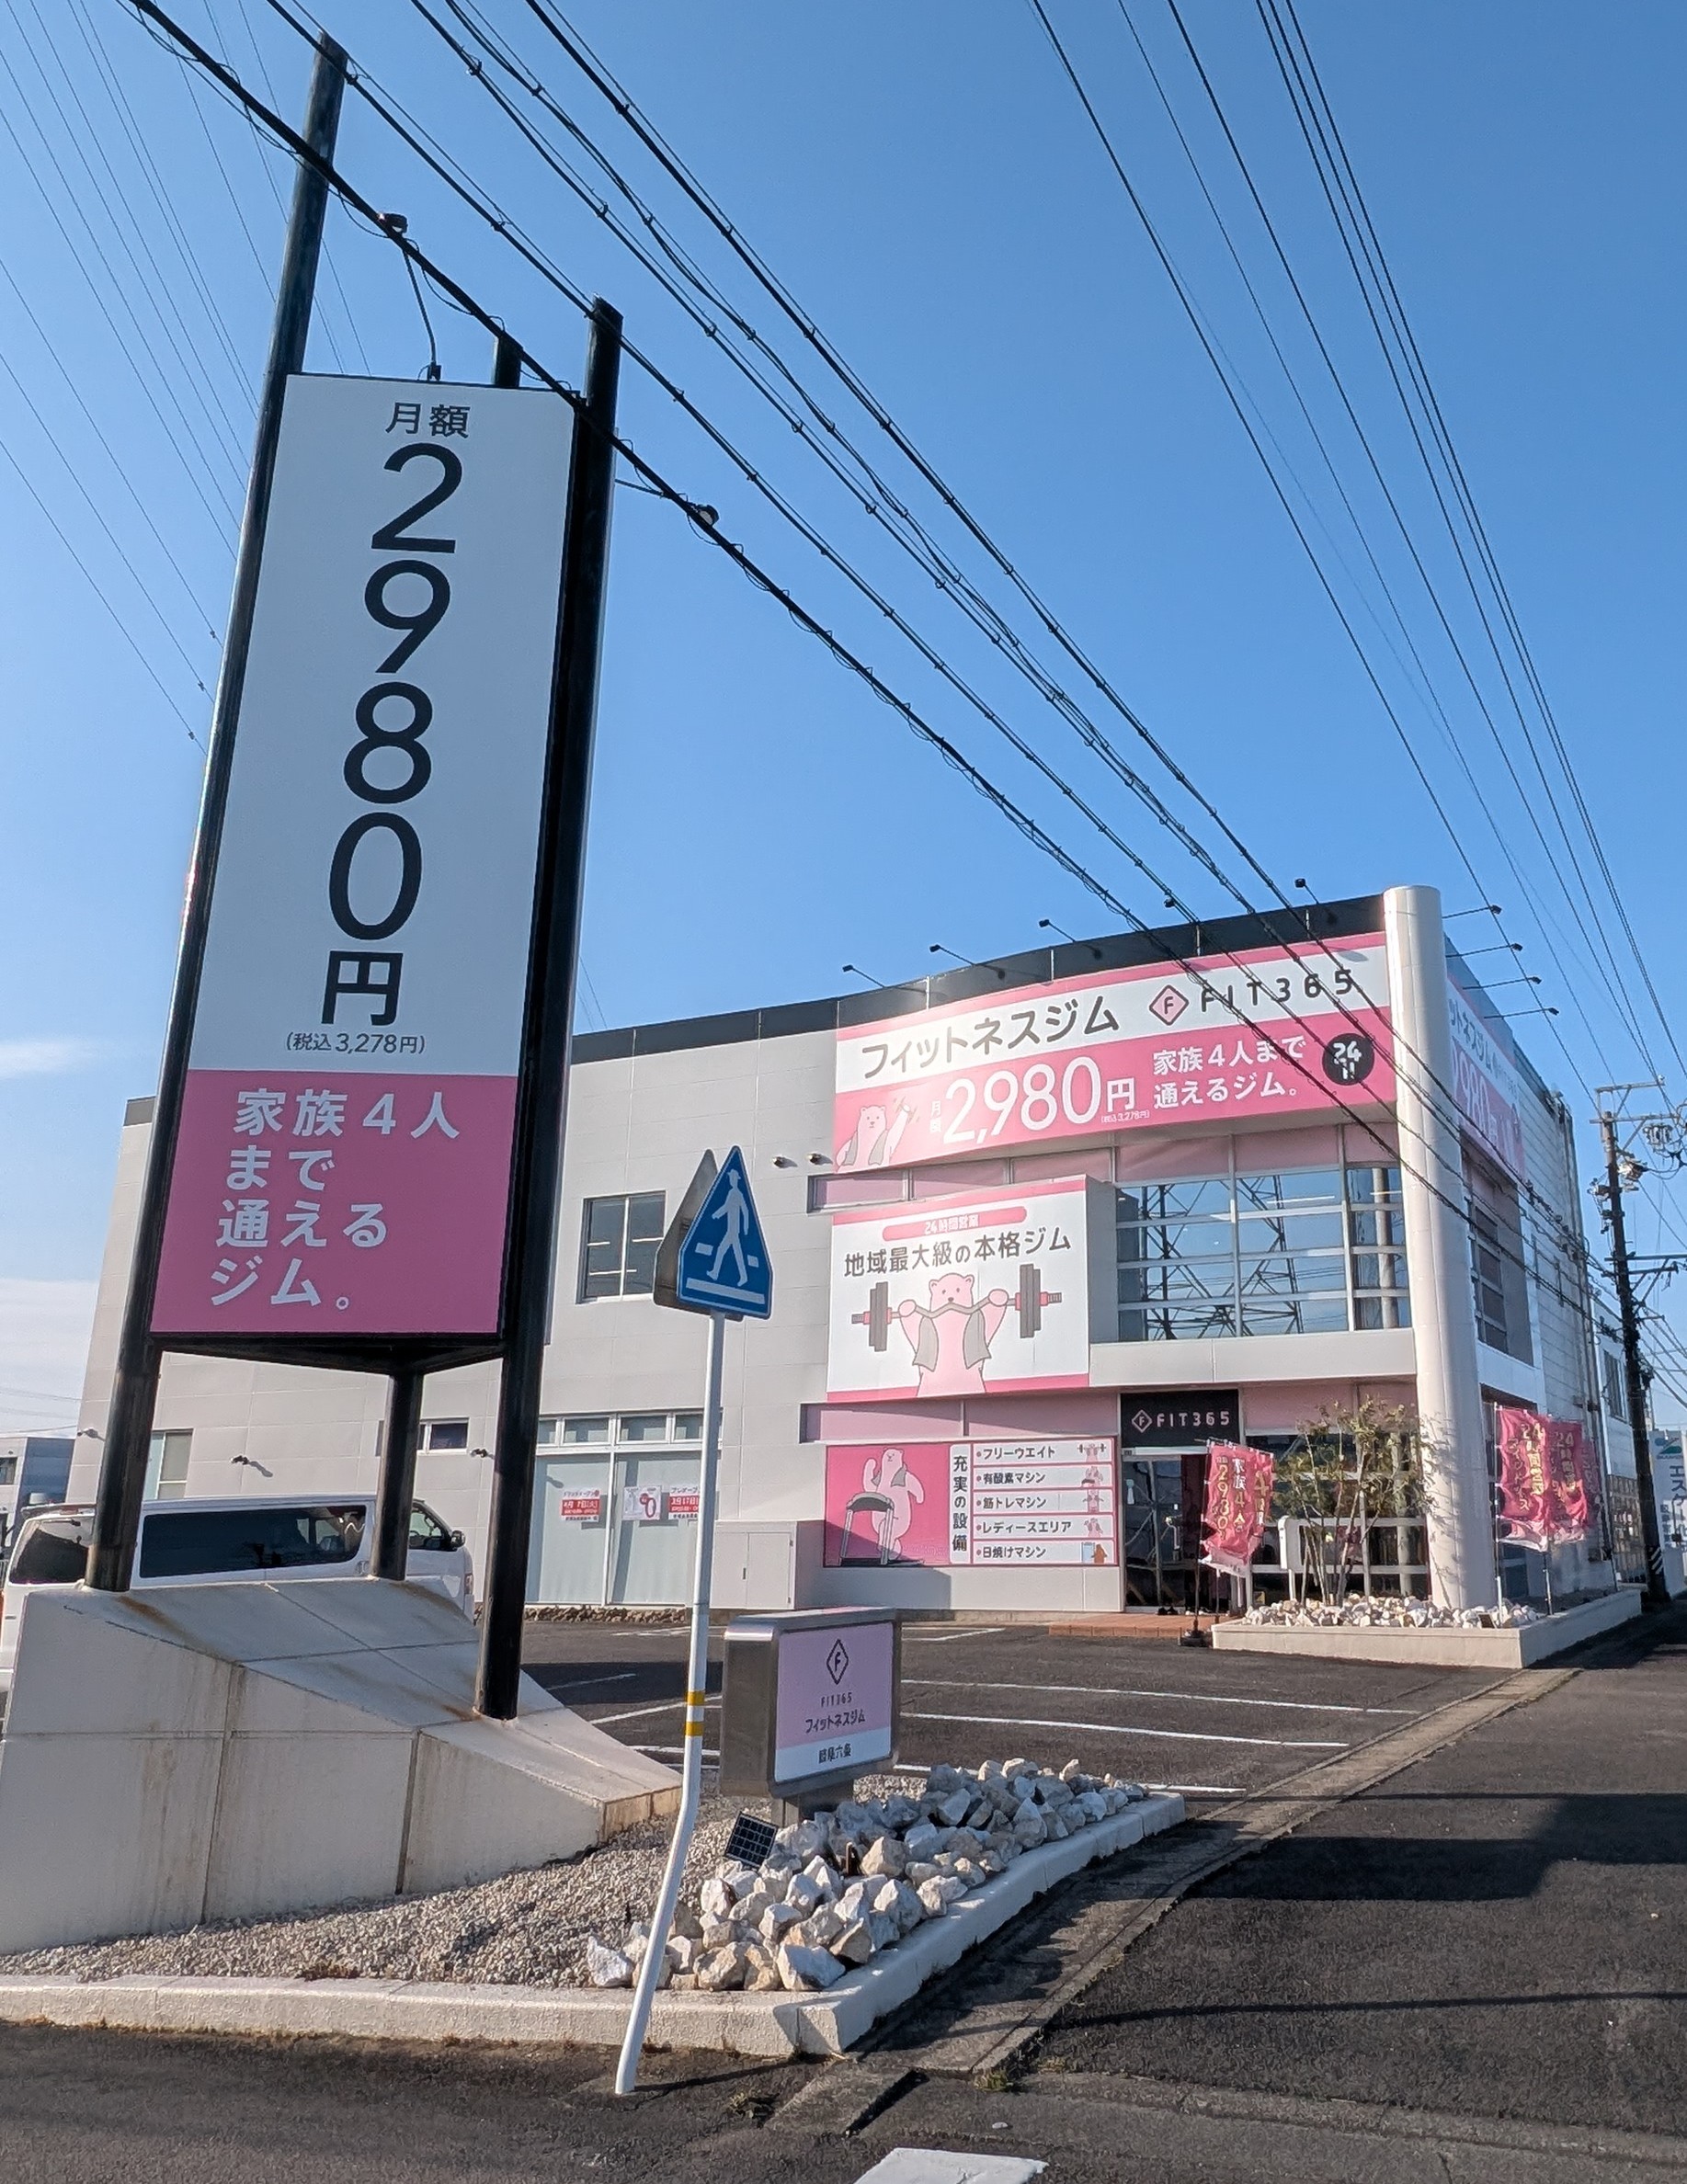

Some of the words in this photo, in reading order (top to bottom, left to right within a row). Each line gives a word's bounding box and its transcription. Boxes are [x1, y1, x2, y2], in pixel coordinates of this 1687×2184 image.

[385, 402, 471, 438] 月額
[320, 442, 463, 1027] 2980円
[1201, 971, 1353, 1012] FIT365
[285, 1031, 426, 1055] (税込3,278円)
[861, 995, 1120, 1080] フィットネスジム
[1153, 1035, 1306, 1075] 家族4人まで
[1333, 1041, 1362, 1064] 24
[942, 1056, 1135, 1143] 2,980円
[1154, 1071, 1297, 1109] 通えるジム。
[233, 1087, 460, 1140] 家族4人
[226, 1144, 335, 1191] まで
[216, 1199, 387, 1247] 通える
[844, 1226, 1071, 1277] 地域最大級の本格ジム
[211, 1255, 349, 1311] ジム。
[1157, 1411, 1230, 1428] FIT365
[983, 1447, 1055, 1460] フリーウエイト
[983, 1472, 1046, 1484] 有酸素マシン
[952, 1455, 969, 1552] 充実の設備
[983, 1496, 1047, 1509] 筋トレマシン
[983, 1519, 1072, 1534] レディースエリア
[983, 1545, 1046, 1559] 日焼けマシン
[805, 1709, 865, 1734] フィットネスジム
